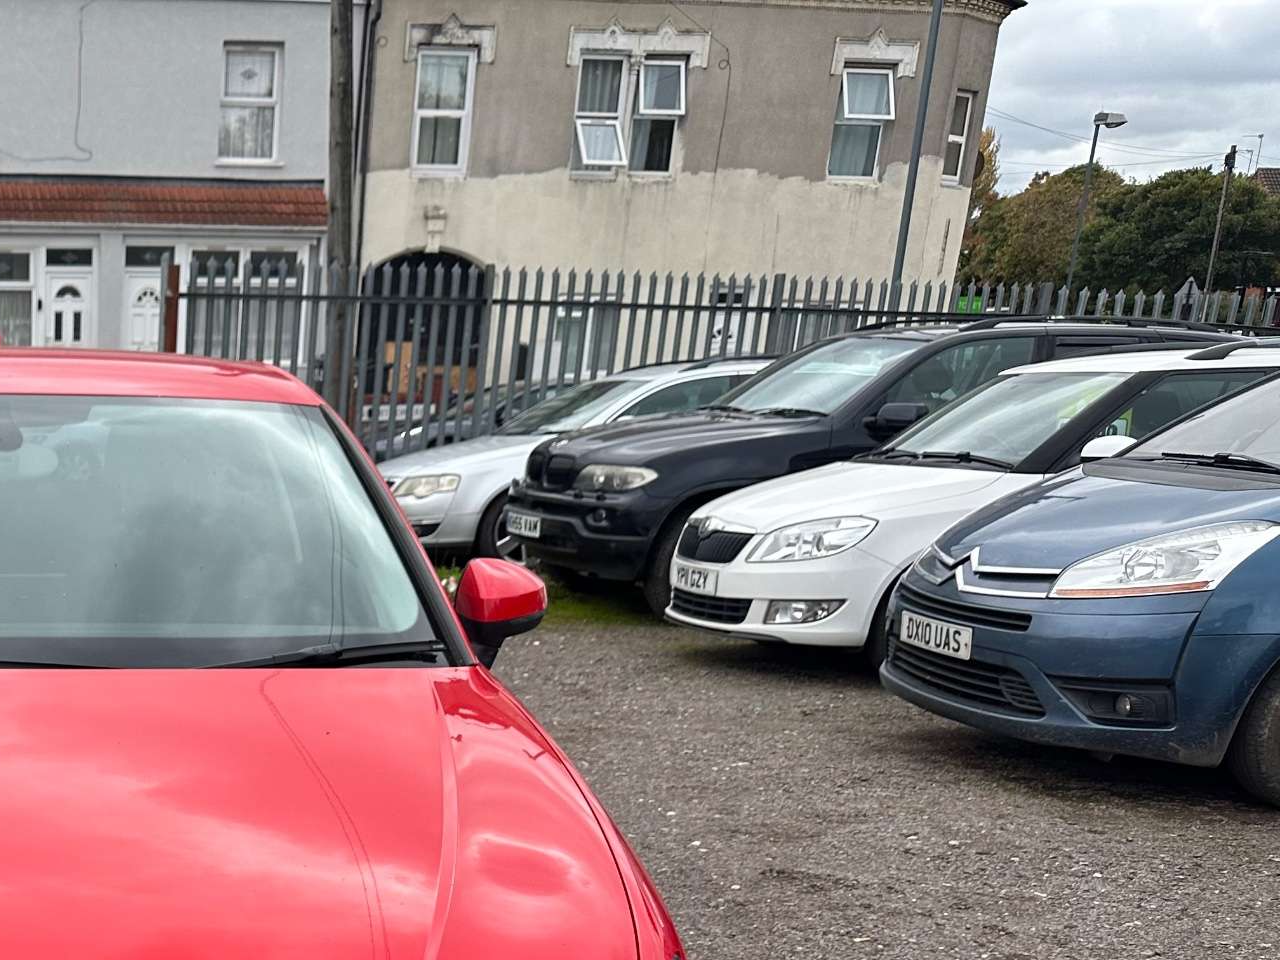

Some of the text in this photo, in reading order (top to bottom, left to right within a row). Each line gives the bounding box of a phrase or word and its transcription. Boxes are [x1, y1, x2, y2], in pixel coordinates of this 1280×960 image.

[690, 568, 710, 590] GZY
[906, 617, 962, 653] DX10 UAS
